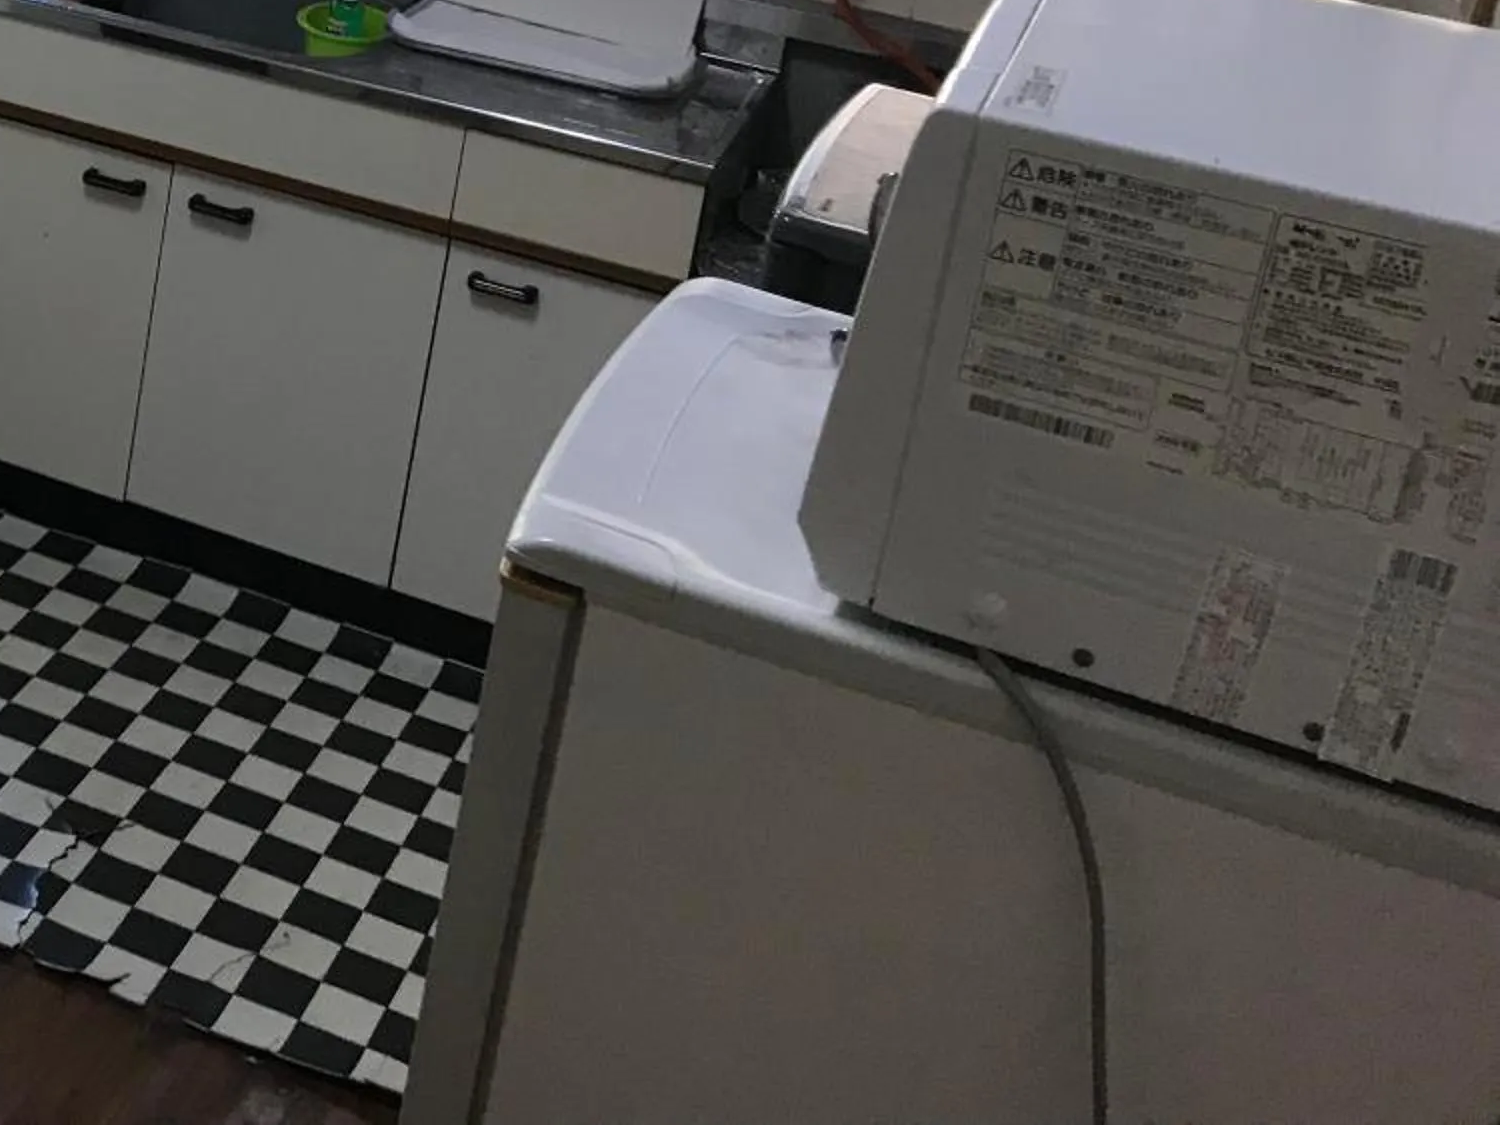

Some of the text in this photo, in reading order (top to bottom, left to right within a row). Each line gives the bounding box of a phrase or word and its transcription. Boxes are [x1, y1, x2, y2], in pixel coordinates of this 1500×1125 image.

[1037, 166, 1077, 186] 危険
[1031, 195, 1068, 220] 警告
[1017, 247, 1057, 271] 注意
